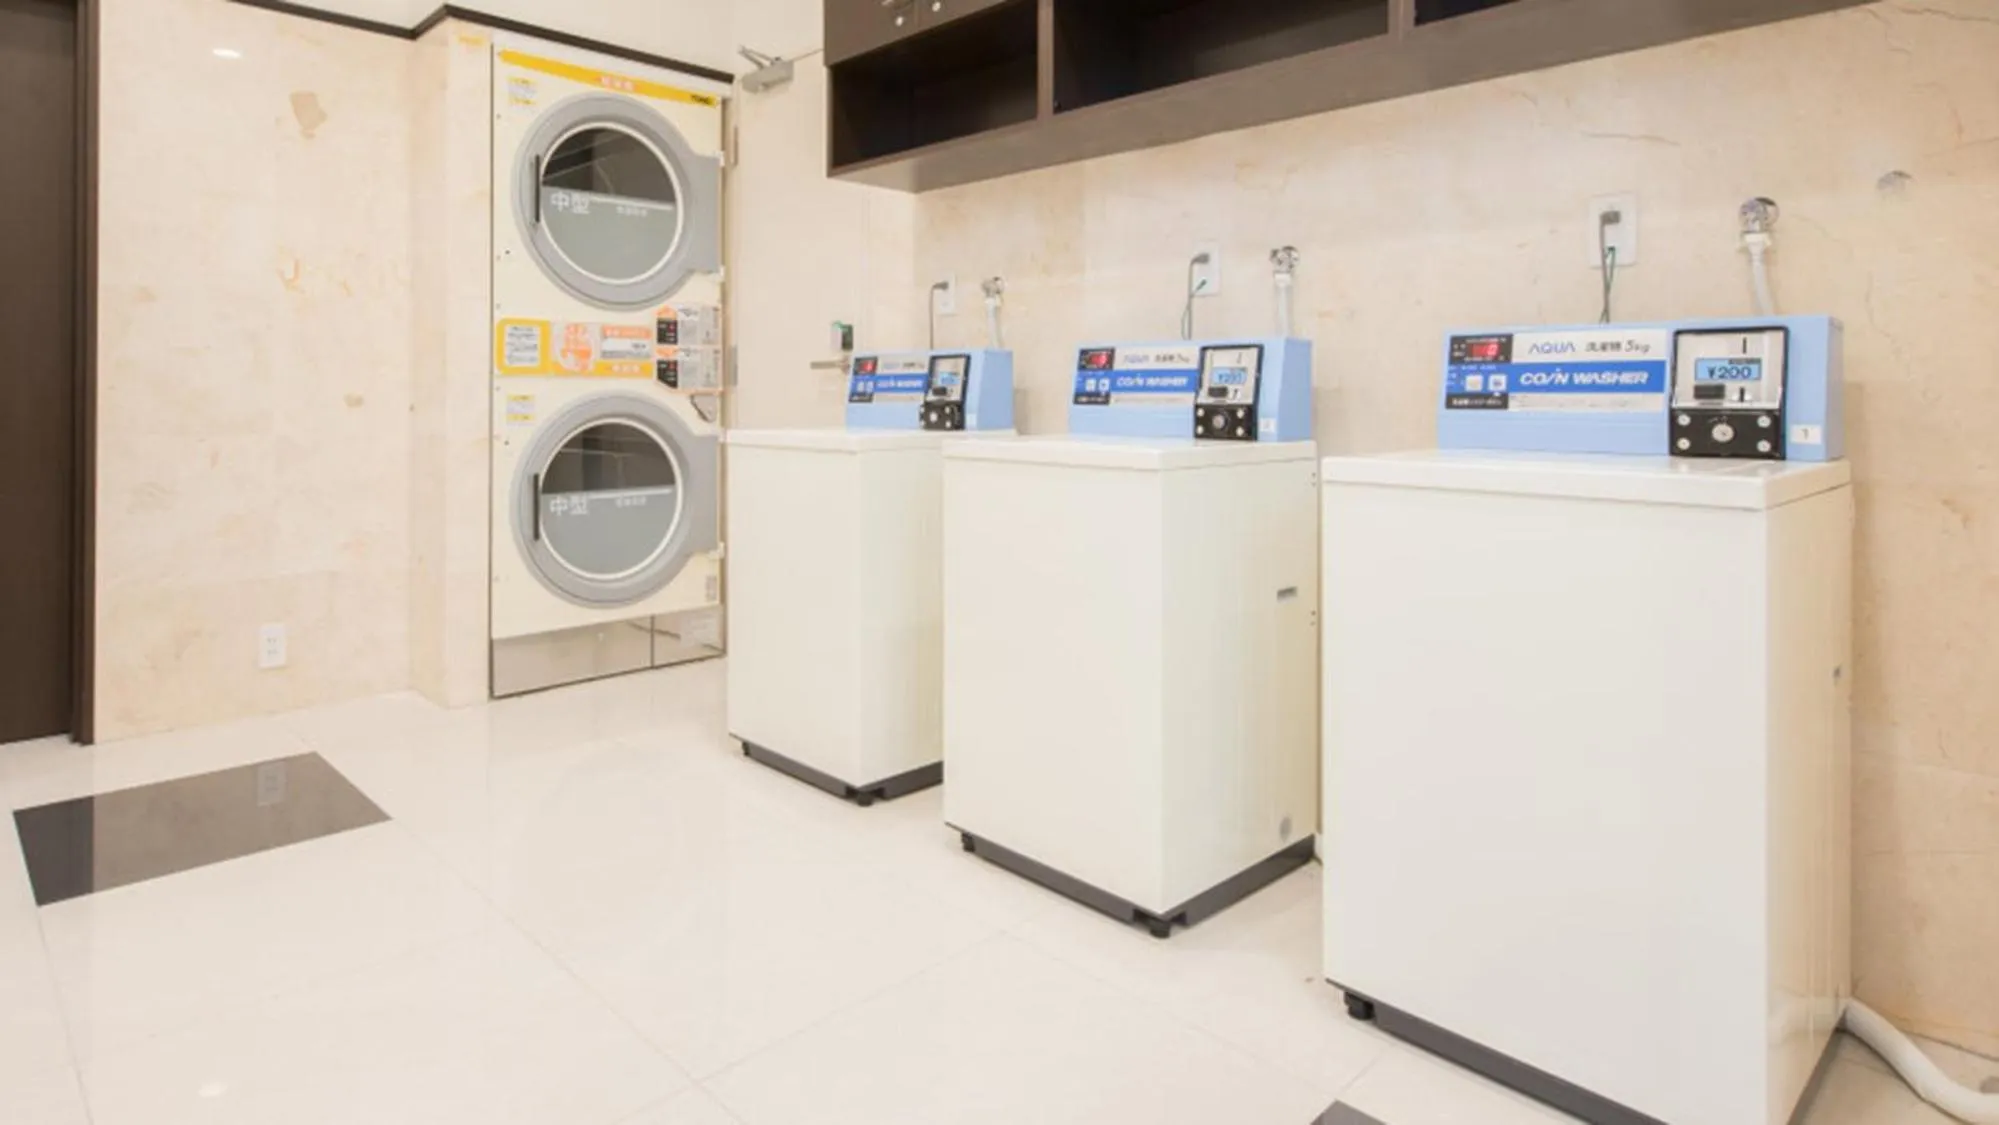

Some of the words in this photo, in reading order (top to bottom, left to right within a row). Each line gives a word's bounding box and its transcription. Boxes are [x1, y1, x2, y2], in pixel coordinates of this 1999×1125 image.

[1528, 341, 1576, 355] AQUA
[1572, 370, 1649, 385] WASHER
[1707, 366, 1752, 380] ¥200
